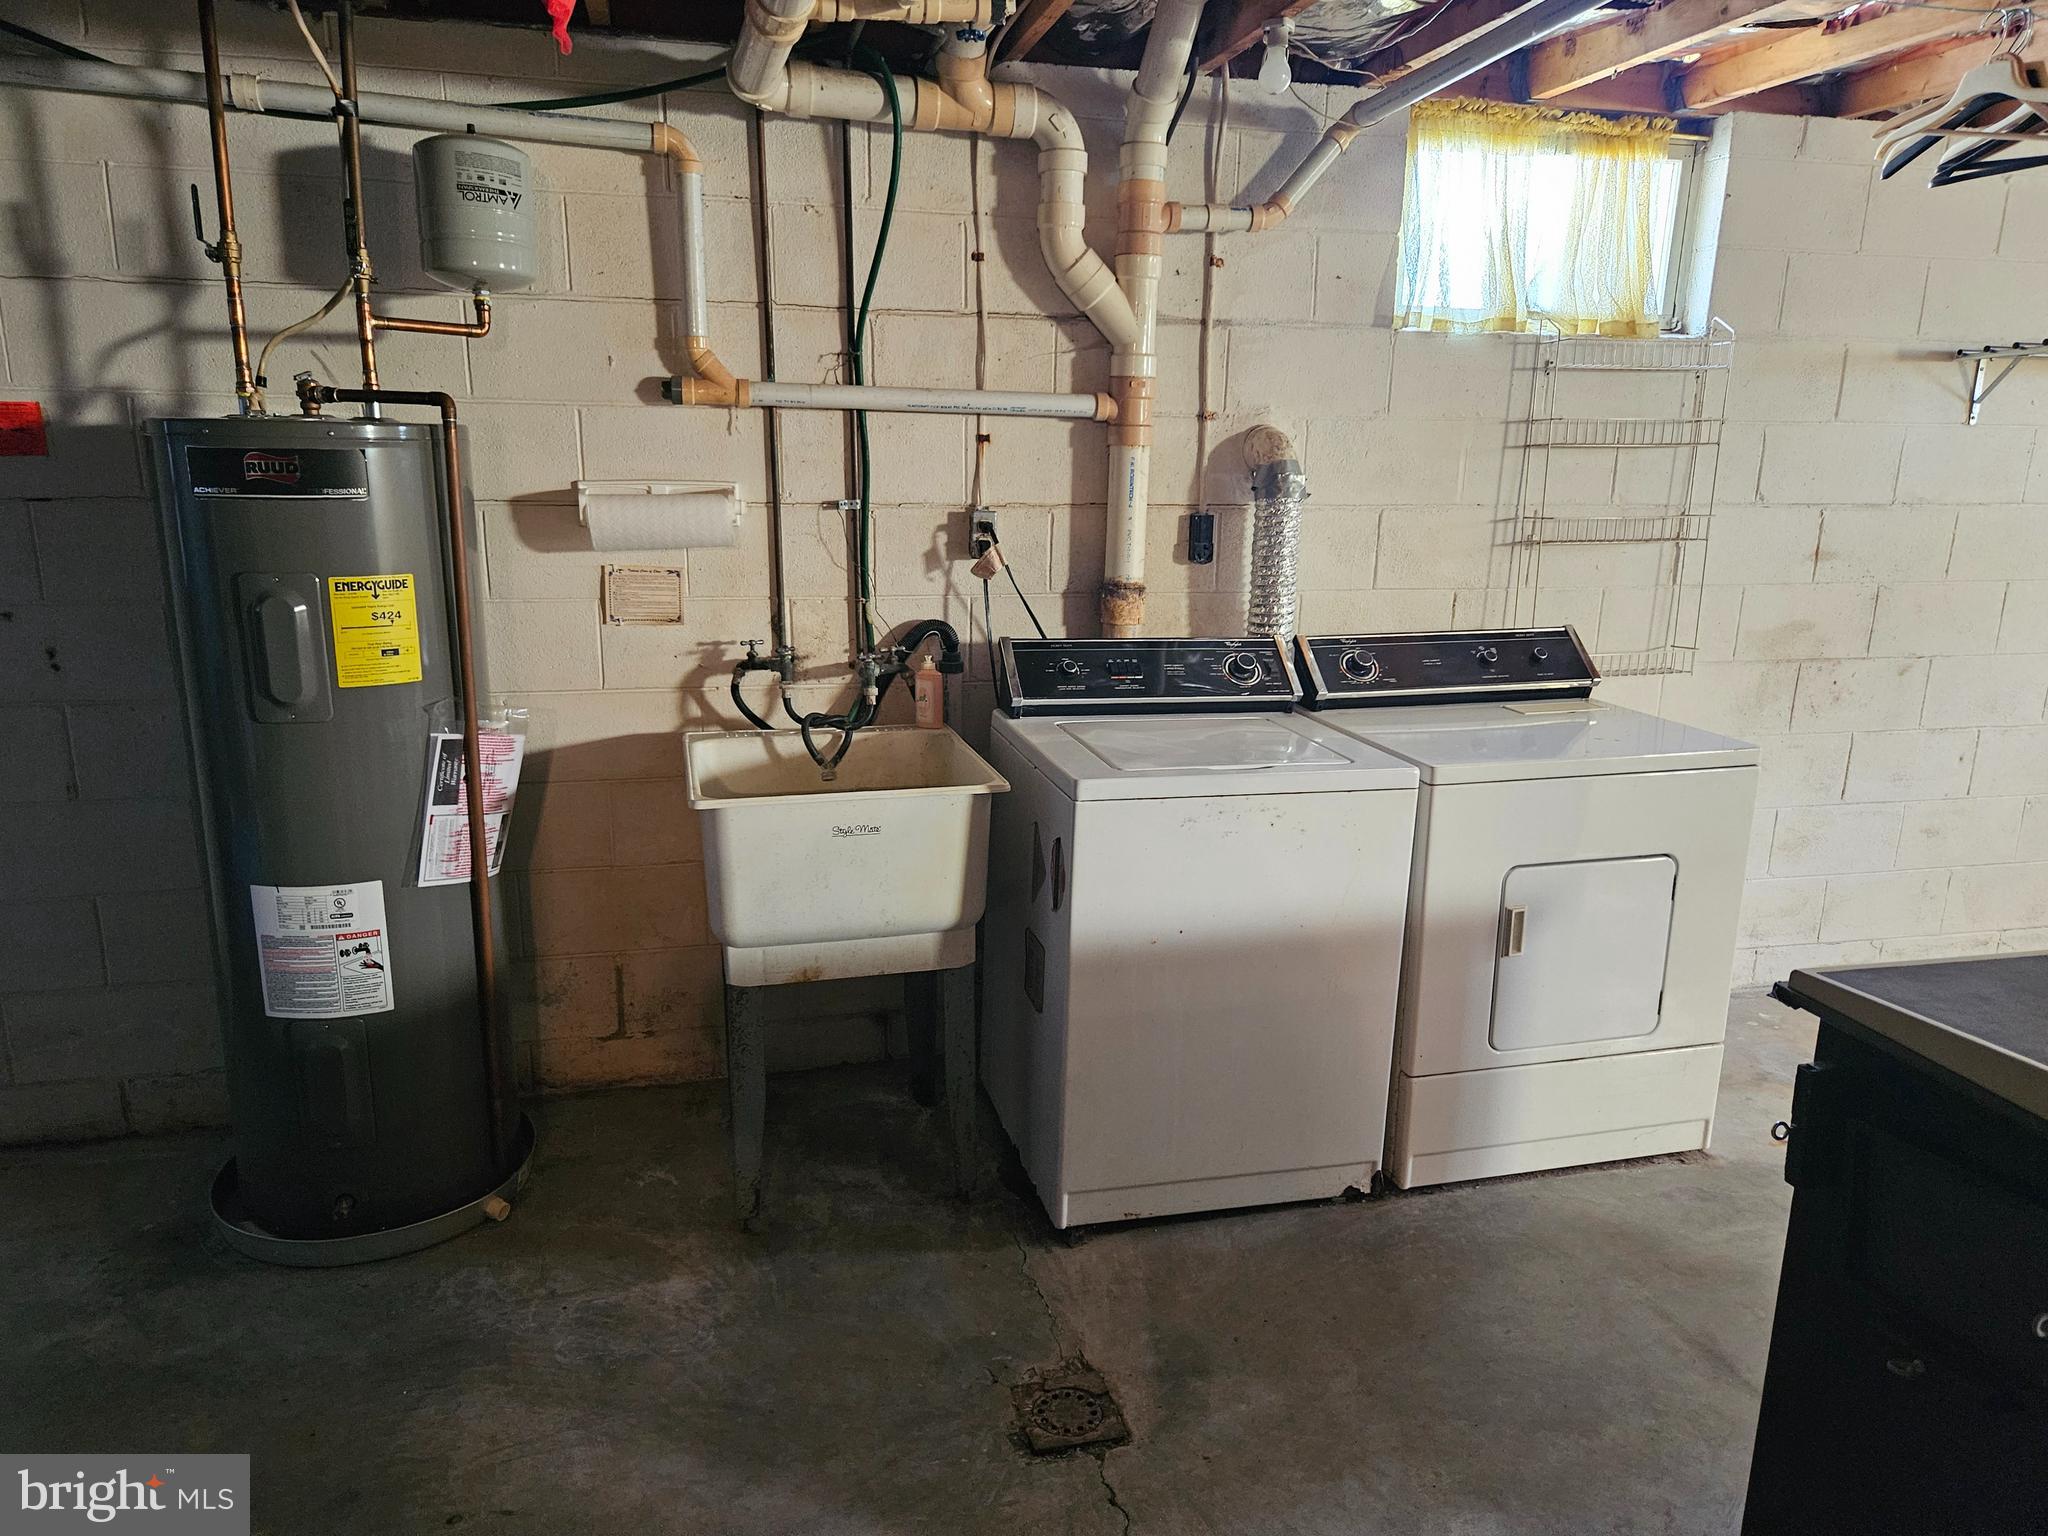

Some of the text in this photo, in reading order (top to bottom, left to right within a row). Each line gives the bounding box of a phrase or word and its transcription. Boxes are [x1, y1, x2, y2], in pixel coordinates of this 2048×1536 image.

[457, 191, 508, 205] AMTROL
[246, 461, 299, 474] RUUD
[334, 579, 409, 595] ENERGYGUIDE
[832, 825, 855, 838] Style
[346, 930, 378, 940] DANGER
